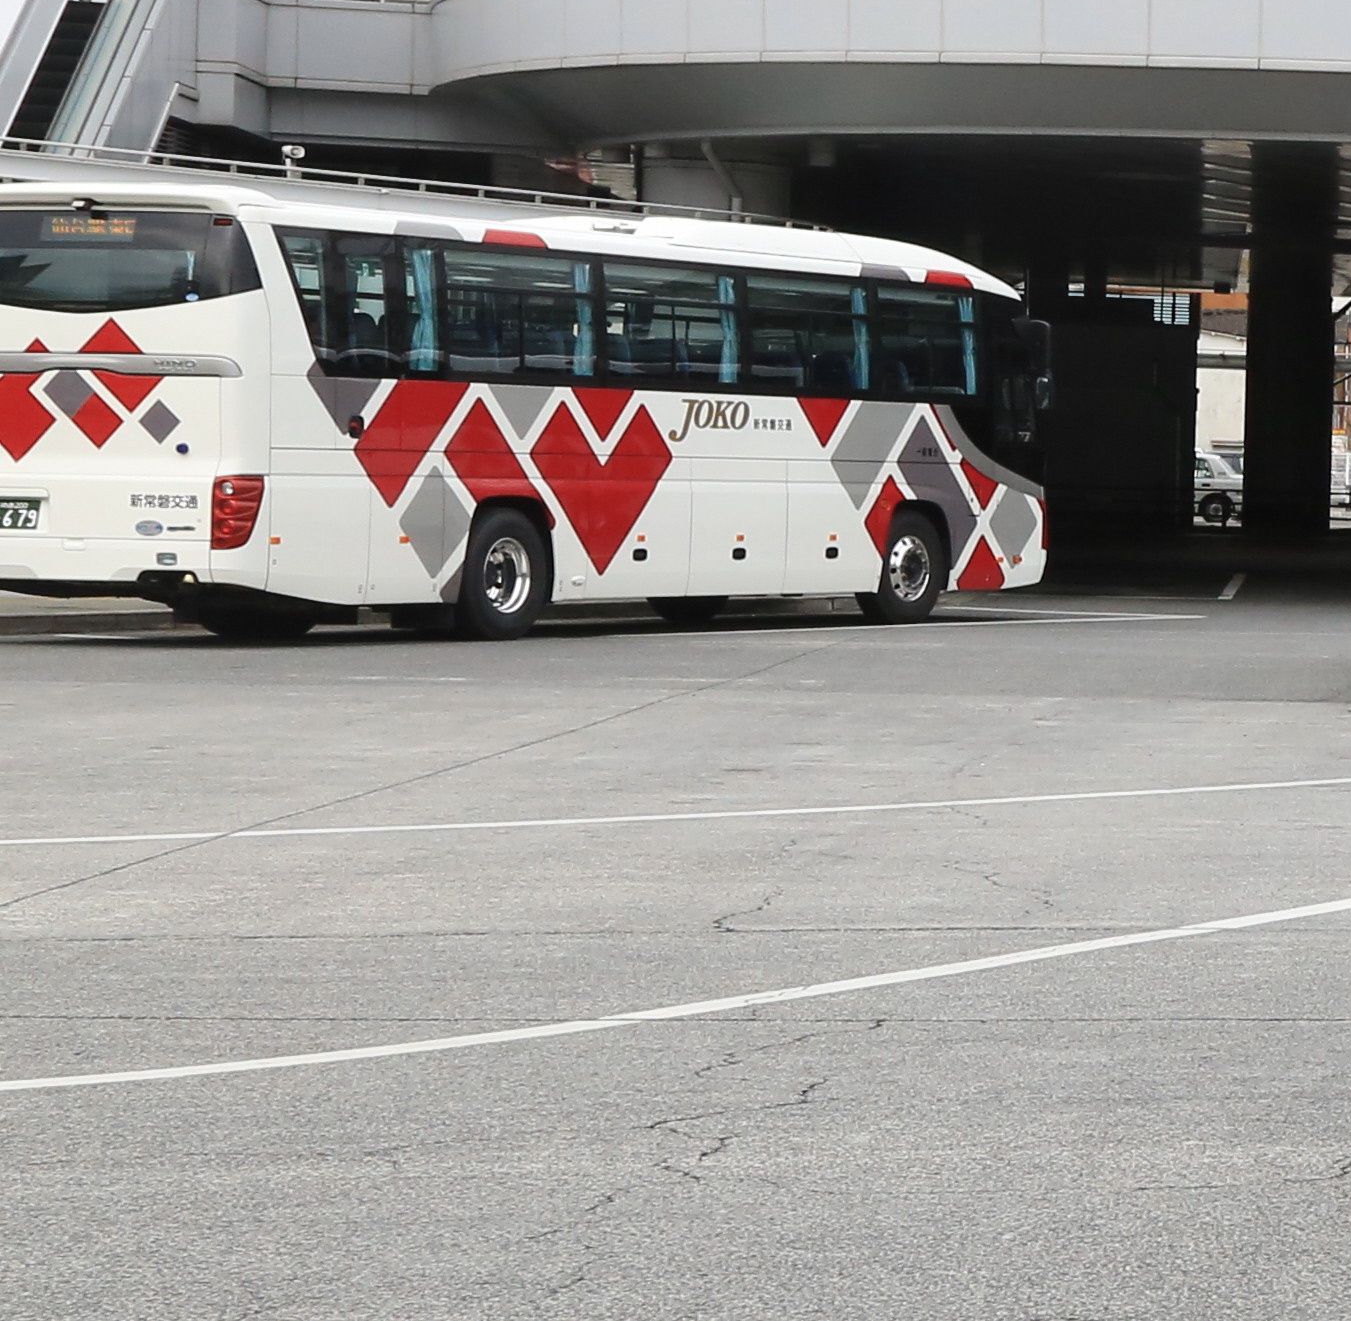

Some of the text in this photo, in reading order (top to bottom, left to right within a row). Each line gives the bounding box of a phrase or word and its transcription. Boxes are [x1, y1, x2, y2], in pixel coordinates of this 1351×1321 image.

[668, 399, 750, 442] JOKO
[129, 494, 199, 509] 新常磐交通
